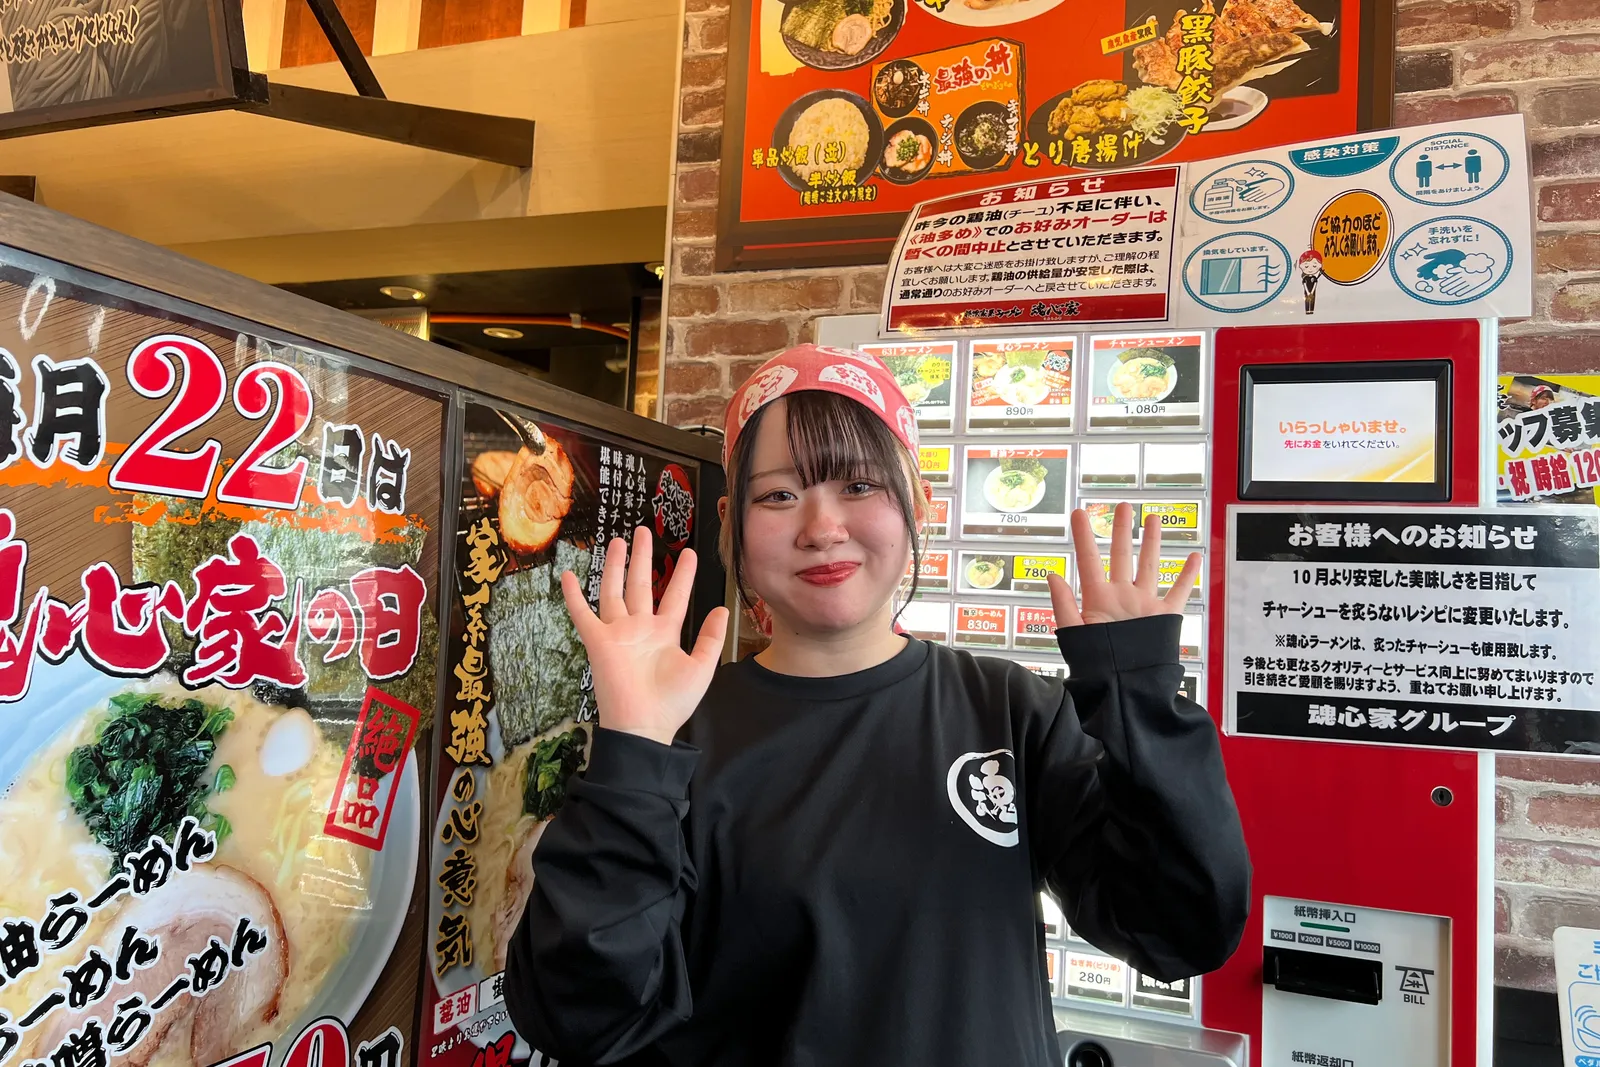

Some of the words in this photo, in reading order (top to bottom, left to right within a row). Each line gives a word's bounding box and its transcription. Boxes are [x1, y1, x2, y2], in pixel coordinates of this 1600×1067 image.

[933, 41, 1013, 94] 最強の丼
[1176, 14, 1214, 135] 黒豚餃子
[1022, 131, 1146, 166] とり唐揚げ
[1303, 141, 1380, 162] 感染対策
[1424, 143, 1470, 152] DISTANCE
[1430, 138, 1464, 147] SOCIAL
[807, 169, 857, 188] 半炒飯
[979, 177, 1106, 206] お知らせ
[912, 194, 1162, 232] 昨今の鶏油(チーユ)不足に伴い、
[1320, 211, 1382, 234] ご協力のほど
[908, 209, 1168, 246] 《油多め》でのお好みオーダーは
[1428, 225, 1473, 235] 手洗いを
[904, 229, 1165, 262] 暫くの間中止とさせていただきます。
[1428, 234, 1480, 245] 忘れずに!
[1202, 245, 1270, 256] 換気をしています。
[903, 249, 1161, 276] お客様へは大変ご迷惑をお掛け致しますが、ご理解の程
[901, 263, 1157, 287] 宜しくお願いします。鶏油の供給量が安定した際は、
[1028, 300, 1082, 317] 魂心家
[1109, 336, 1186, 348] チャーシューメン
[1005, 406, 1034, 416] 890円
[1279, 420, 1408, 435] いらっしゃいませ。
[1284, 439, 1400, 450] 先にお金をいれてください。
[1000, 513, 1028, 524] 780円
[1160, 515, 1187, 526] 80円
[1288, 522, 1538, 551] お客様へのお知らせ
[1023, 558, 1057, 567] 塩ラーメン
[1292, 568, 1538, 592] 10月より安定した美味しさを目指して
[967, 620, 998, 631] 830円
[1262, 600, 1570, 630] チャーシューを炙らないレシピに変更いたします。
[1275, 633, 1558, 661] ※魂心ラーメンは、炙ったチャーシューも使用致します。
[1242, 655, 1595, 687] 今後とも更なるクオリティーとサービス向上に努めてまいりますので
[1244, 672, 1564, 703] 引き続きご愛顧を賜りますよう、重ねてお願い申し上げます。
[1307, 702, 1517, 737] 魂心家グループ
[343, 708, 402, 831] 絶品
[1293, 904, 1356, 923] 紙幣挿入口
[1272, 931, 1294, 941] ¥1000
[1300, 934, 1322, 945] ¥2000
[1328, 938, 1350, 949] ¥5000
[1355, 942, 1380, 953] ¥10000
[1079, 971, 1111, 986] 280円
[438, 991, 472, 1025] 醤油
[1403, 993, 1426, 1006] BILL
[1291, 1050, 1354, 1067] 紙幣返却口
